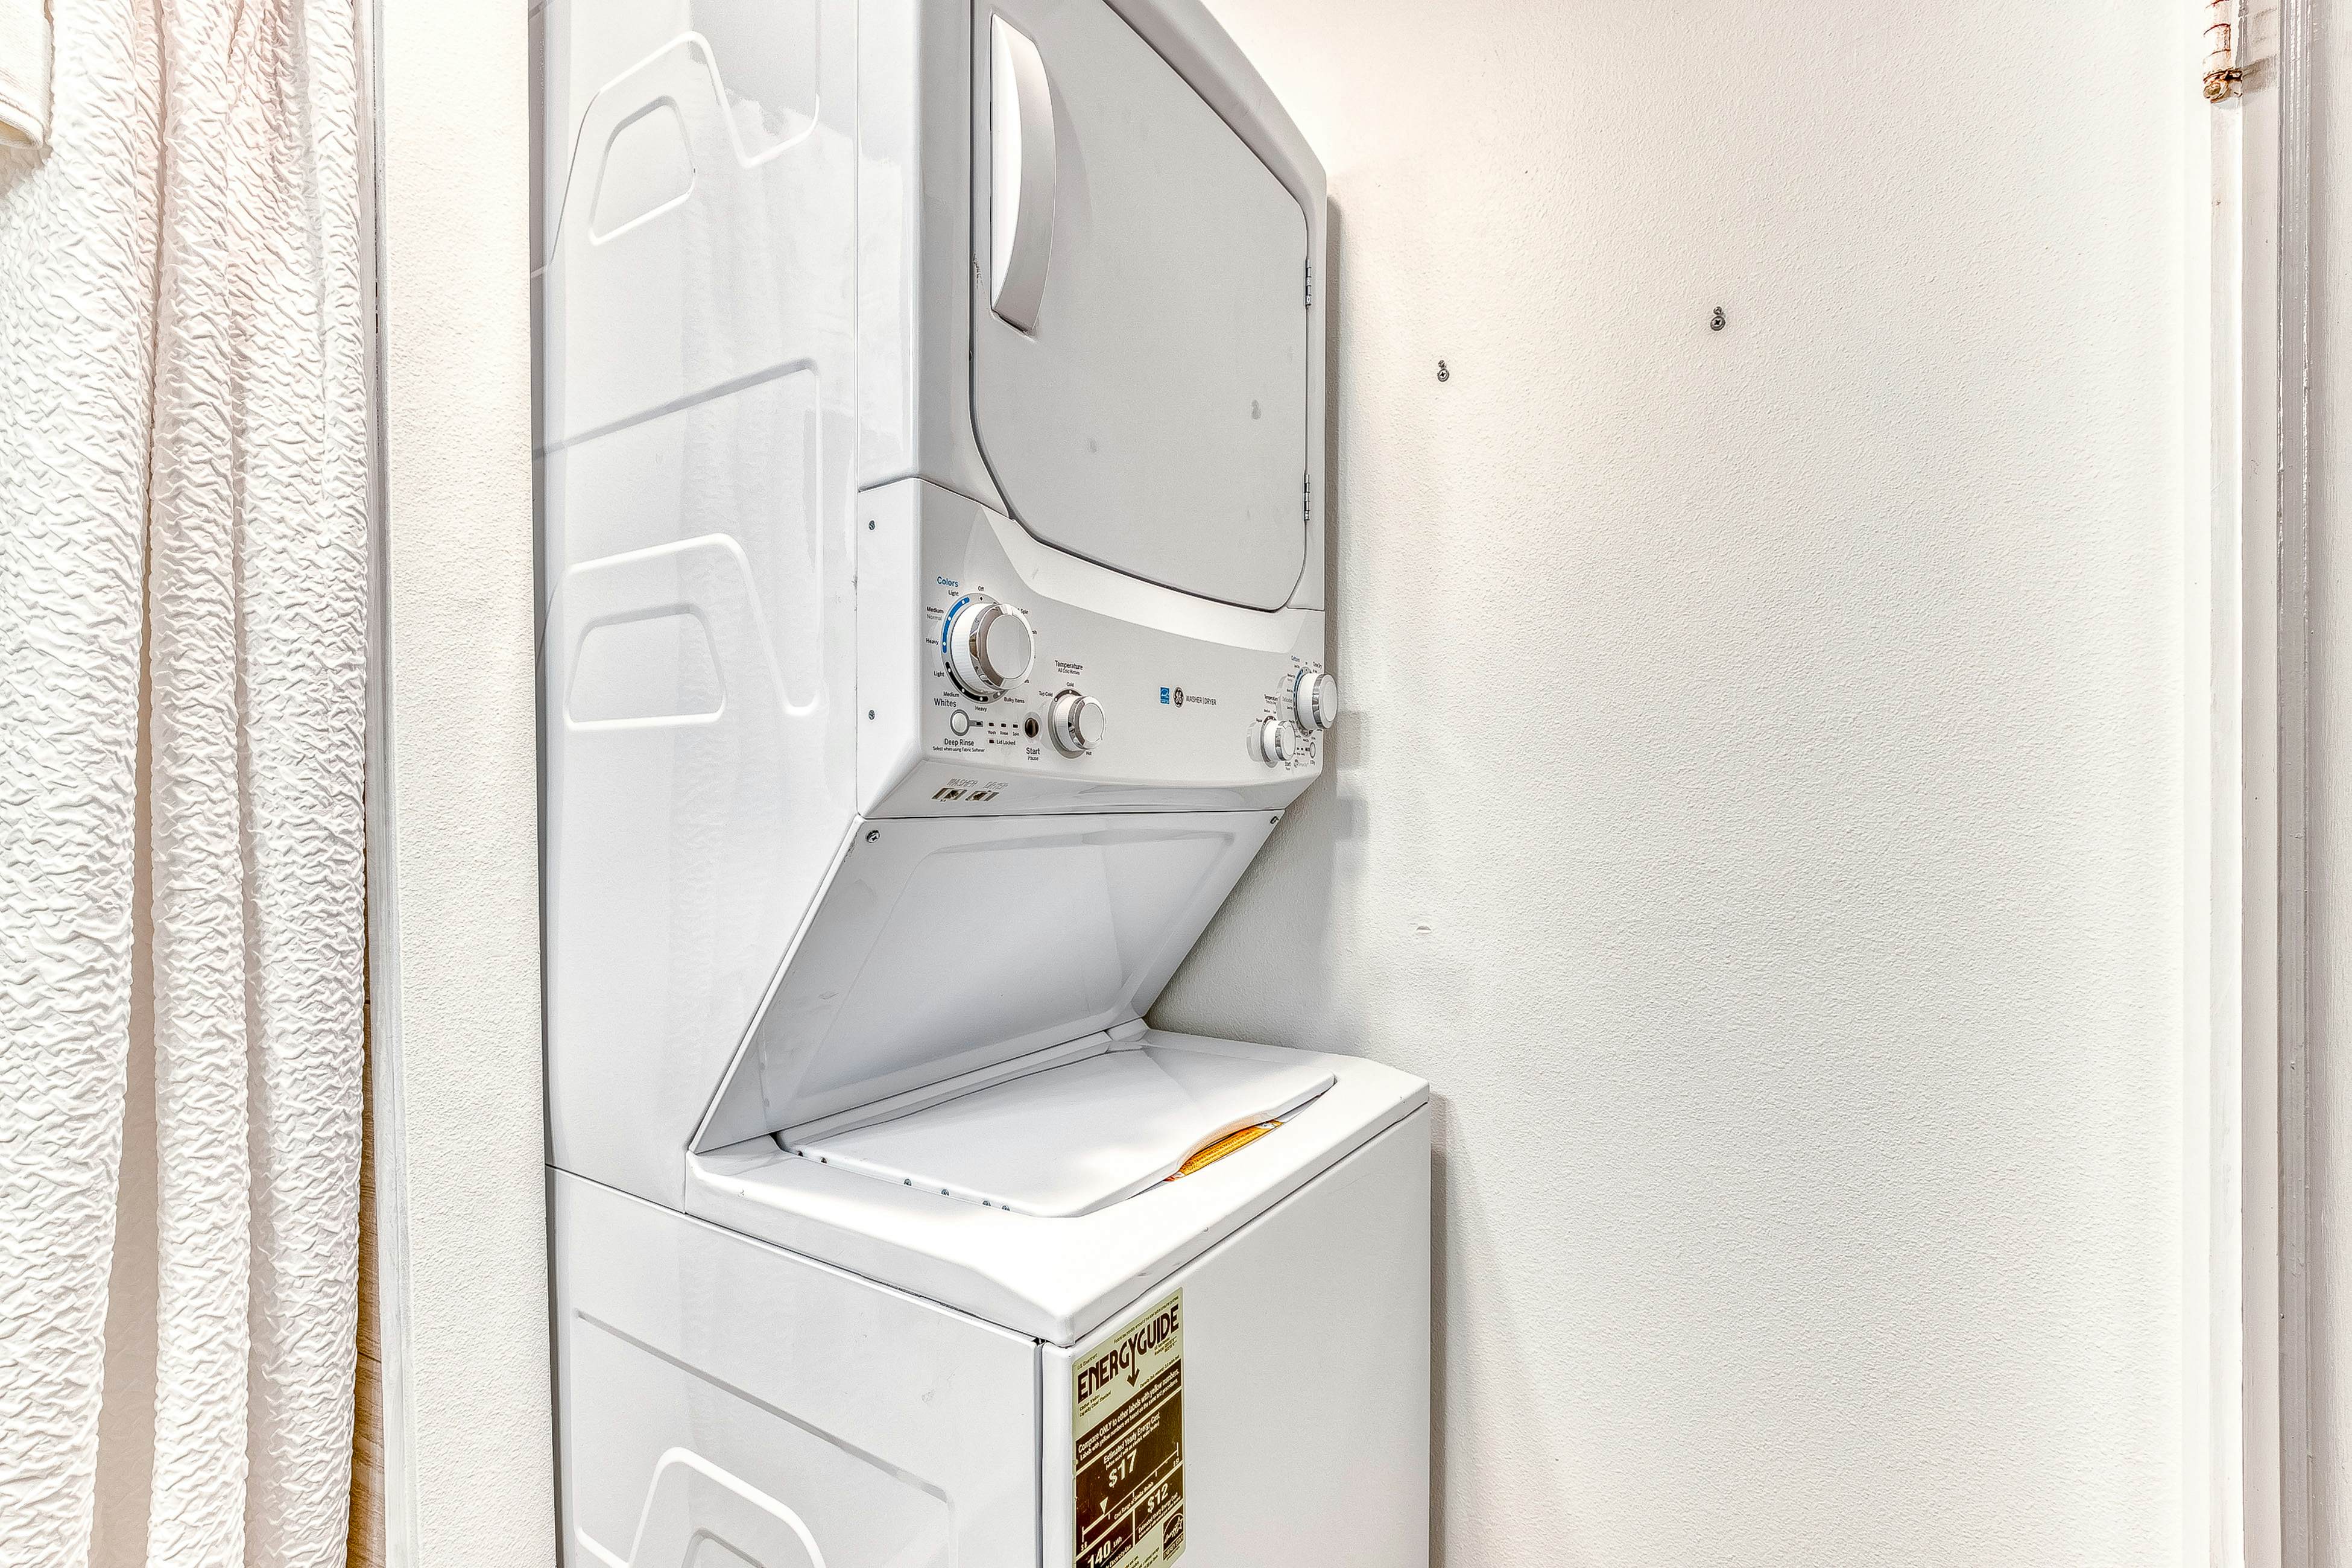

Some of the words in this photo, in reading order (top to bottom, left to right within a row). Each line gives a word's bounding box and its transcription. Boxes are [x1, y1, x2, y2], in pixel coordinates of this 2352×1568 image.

[937, 577, 959, 587] Colors
[1054, 660, 1083, 671] Temperature
[934, 698, 957, 707] Whites
[1186, 695, 1203, 704] WASHER
[1204, 697, 1217, 706] DRYER
[944, 738, 958, 747] Deep
[1077, 1303, 1179, 1404] ENERGYGUIDE
[1078, 1433, 1099, 1453] Compare
[1099, 1420, 1111, 1436] ONLY
[1117, 1409, 1128, 1422] other
[1128, 1399, 1140, 1414] labels
[1140, 1391, 1149, 1403] with
[1149, 1382, 1162, 1398] yellow
[1080, 1448, 1092, 1460] Labels
[1099, 1434, 1110, 1446] yellow
[1110, 1422, 1124, 1436] numbers
[1129, 1408, 1139, 1420] based
[1104, 1441, 1124, 1464] Estimated
[1124, 1432, 1136, 1446] Yearly
[1137, 1420, 1150, 1436] Energy
[1151, 1411, 1160, 1423] Cost
[1109, 1449, 1136, 1487] $17
[1148, 1483, 1168, 1513] $12
[1138, 1516, 1152, 1533] Estimated
[1087, 1540, 1110, 1568] 140
[1109, 1550, 1125, 1567] Electricity
